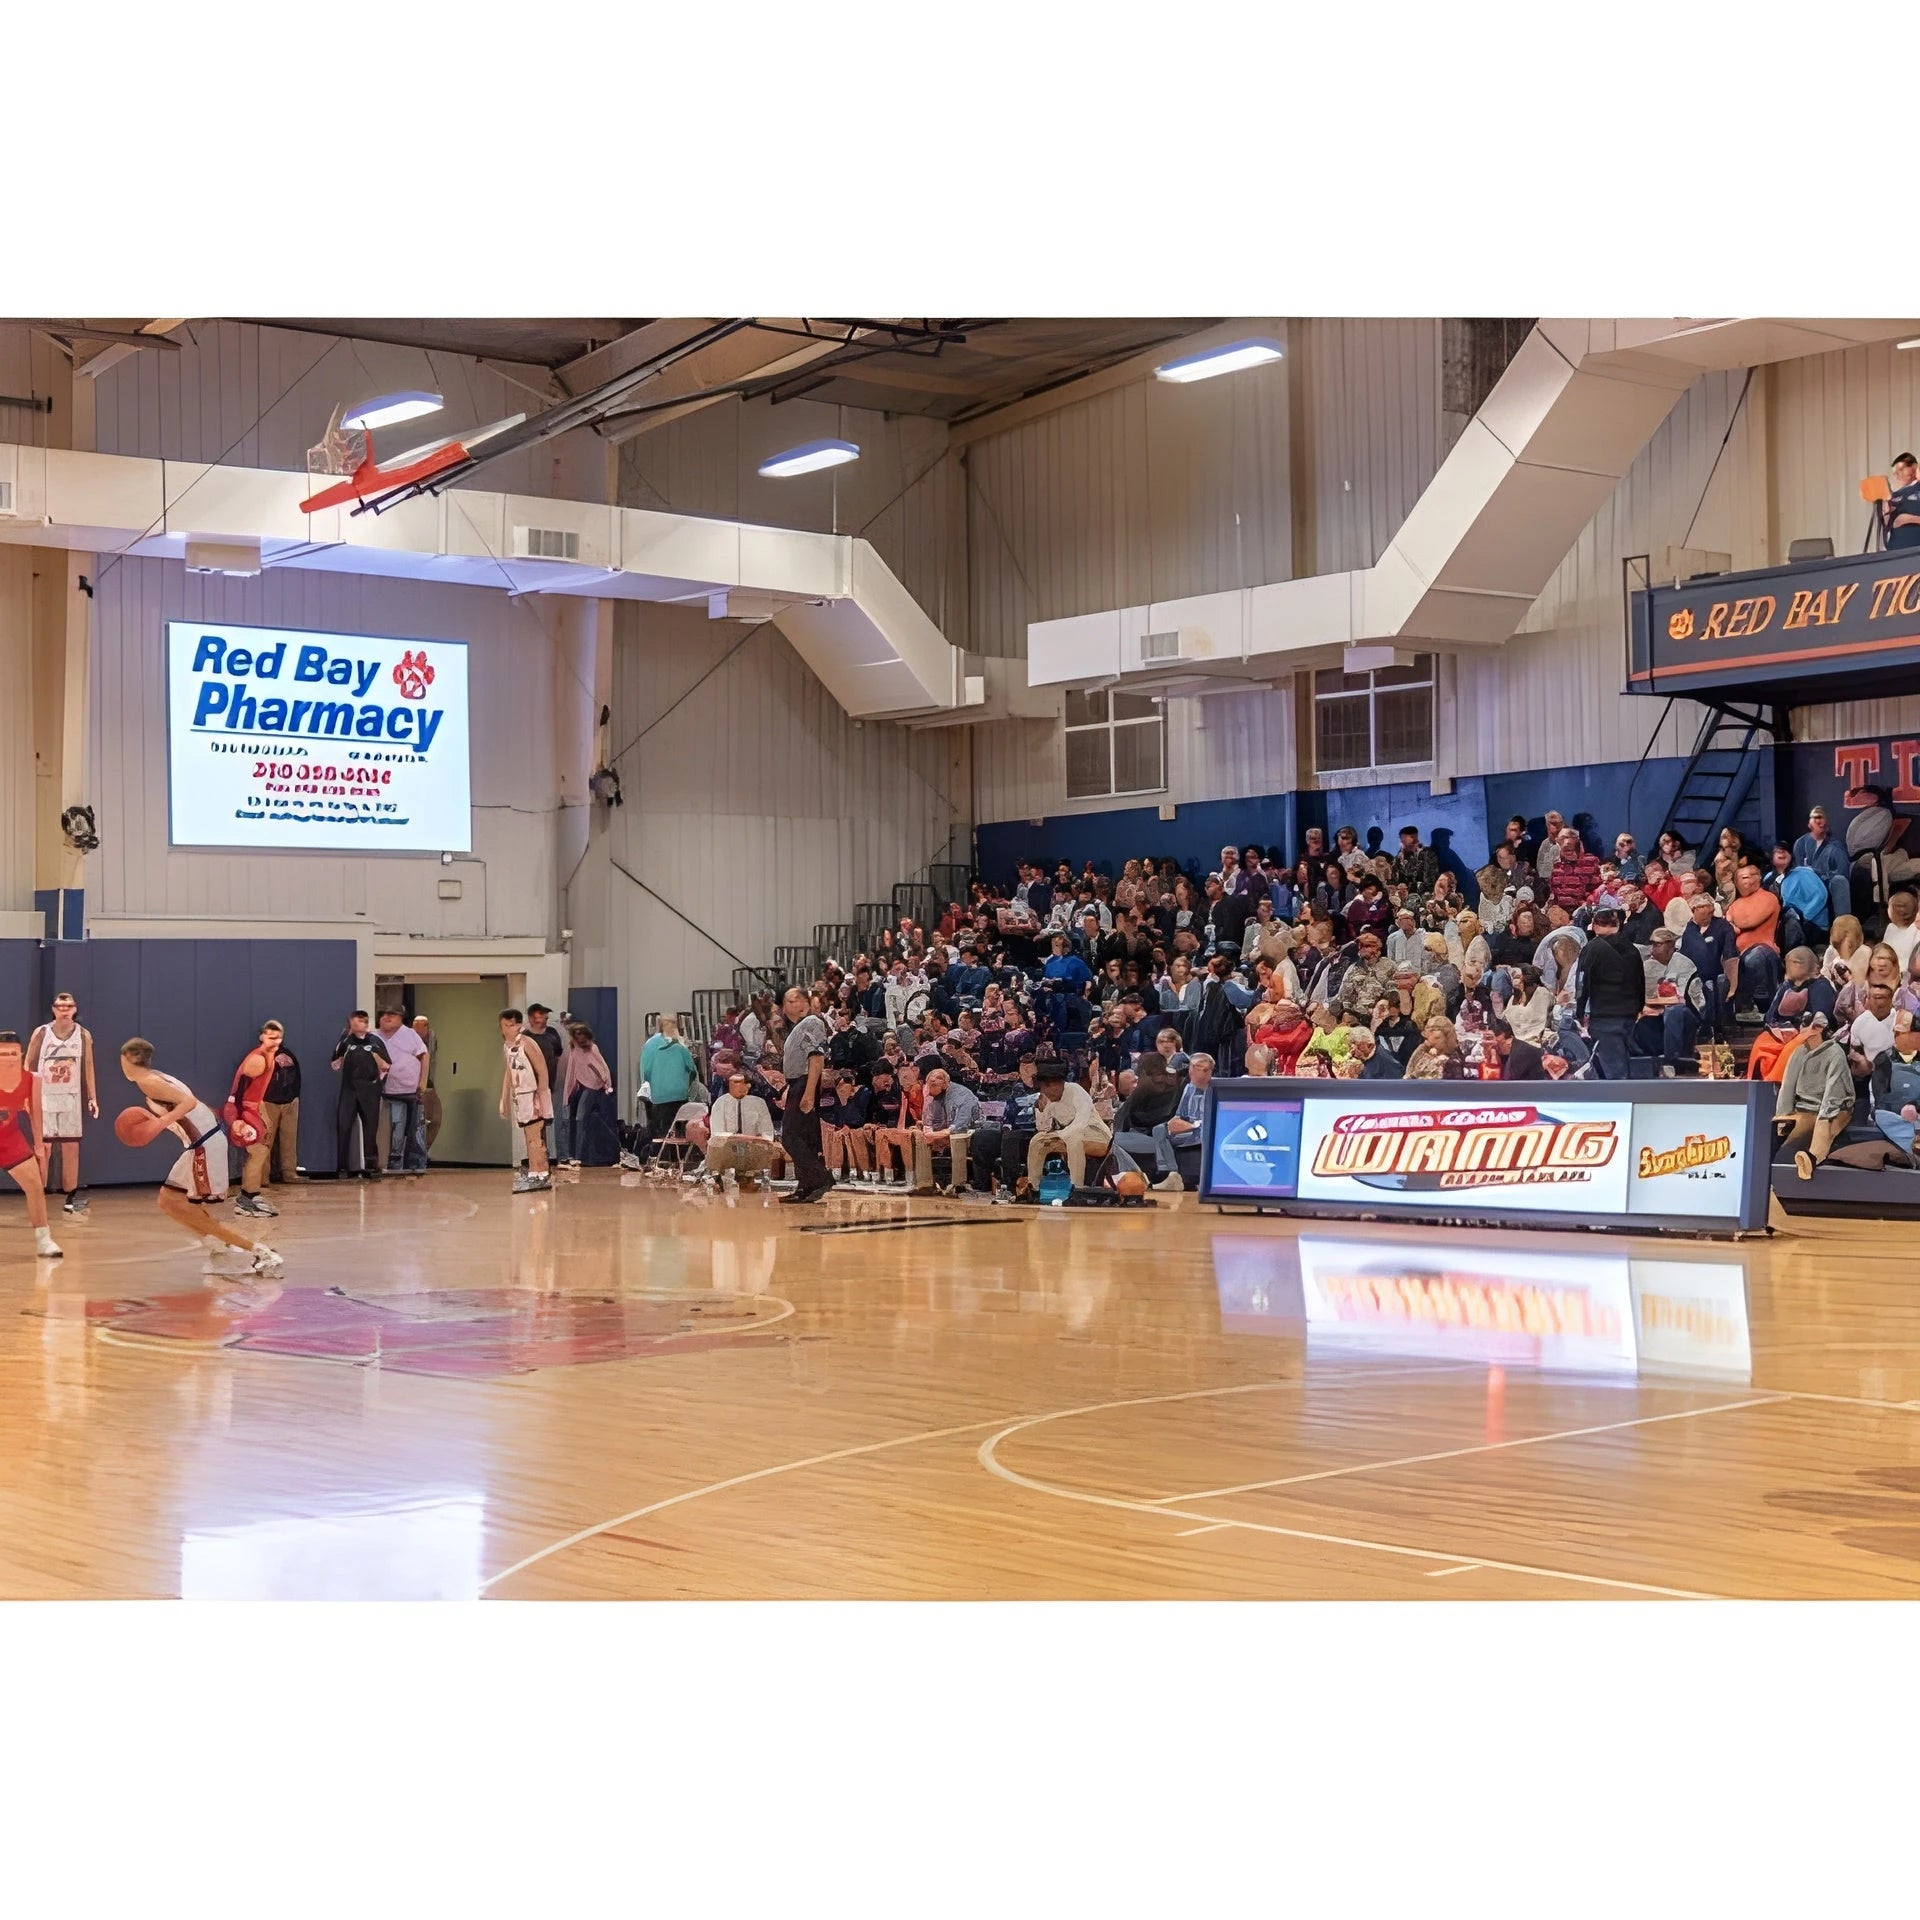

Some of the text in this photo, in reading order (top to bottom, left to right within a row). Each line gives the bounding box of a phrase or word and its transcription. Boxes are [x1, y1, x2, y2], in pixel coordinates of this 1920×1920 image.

[1699, 596, 1776, 640] RED
[1783, 582, 1858, 630] BAY
[192, 635, 381, 697] Red Bay
[193, 681, 444, 753] Pharmacy
